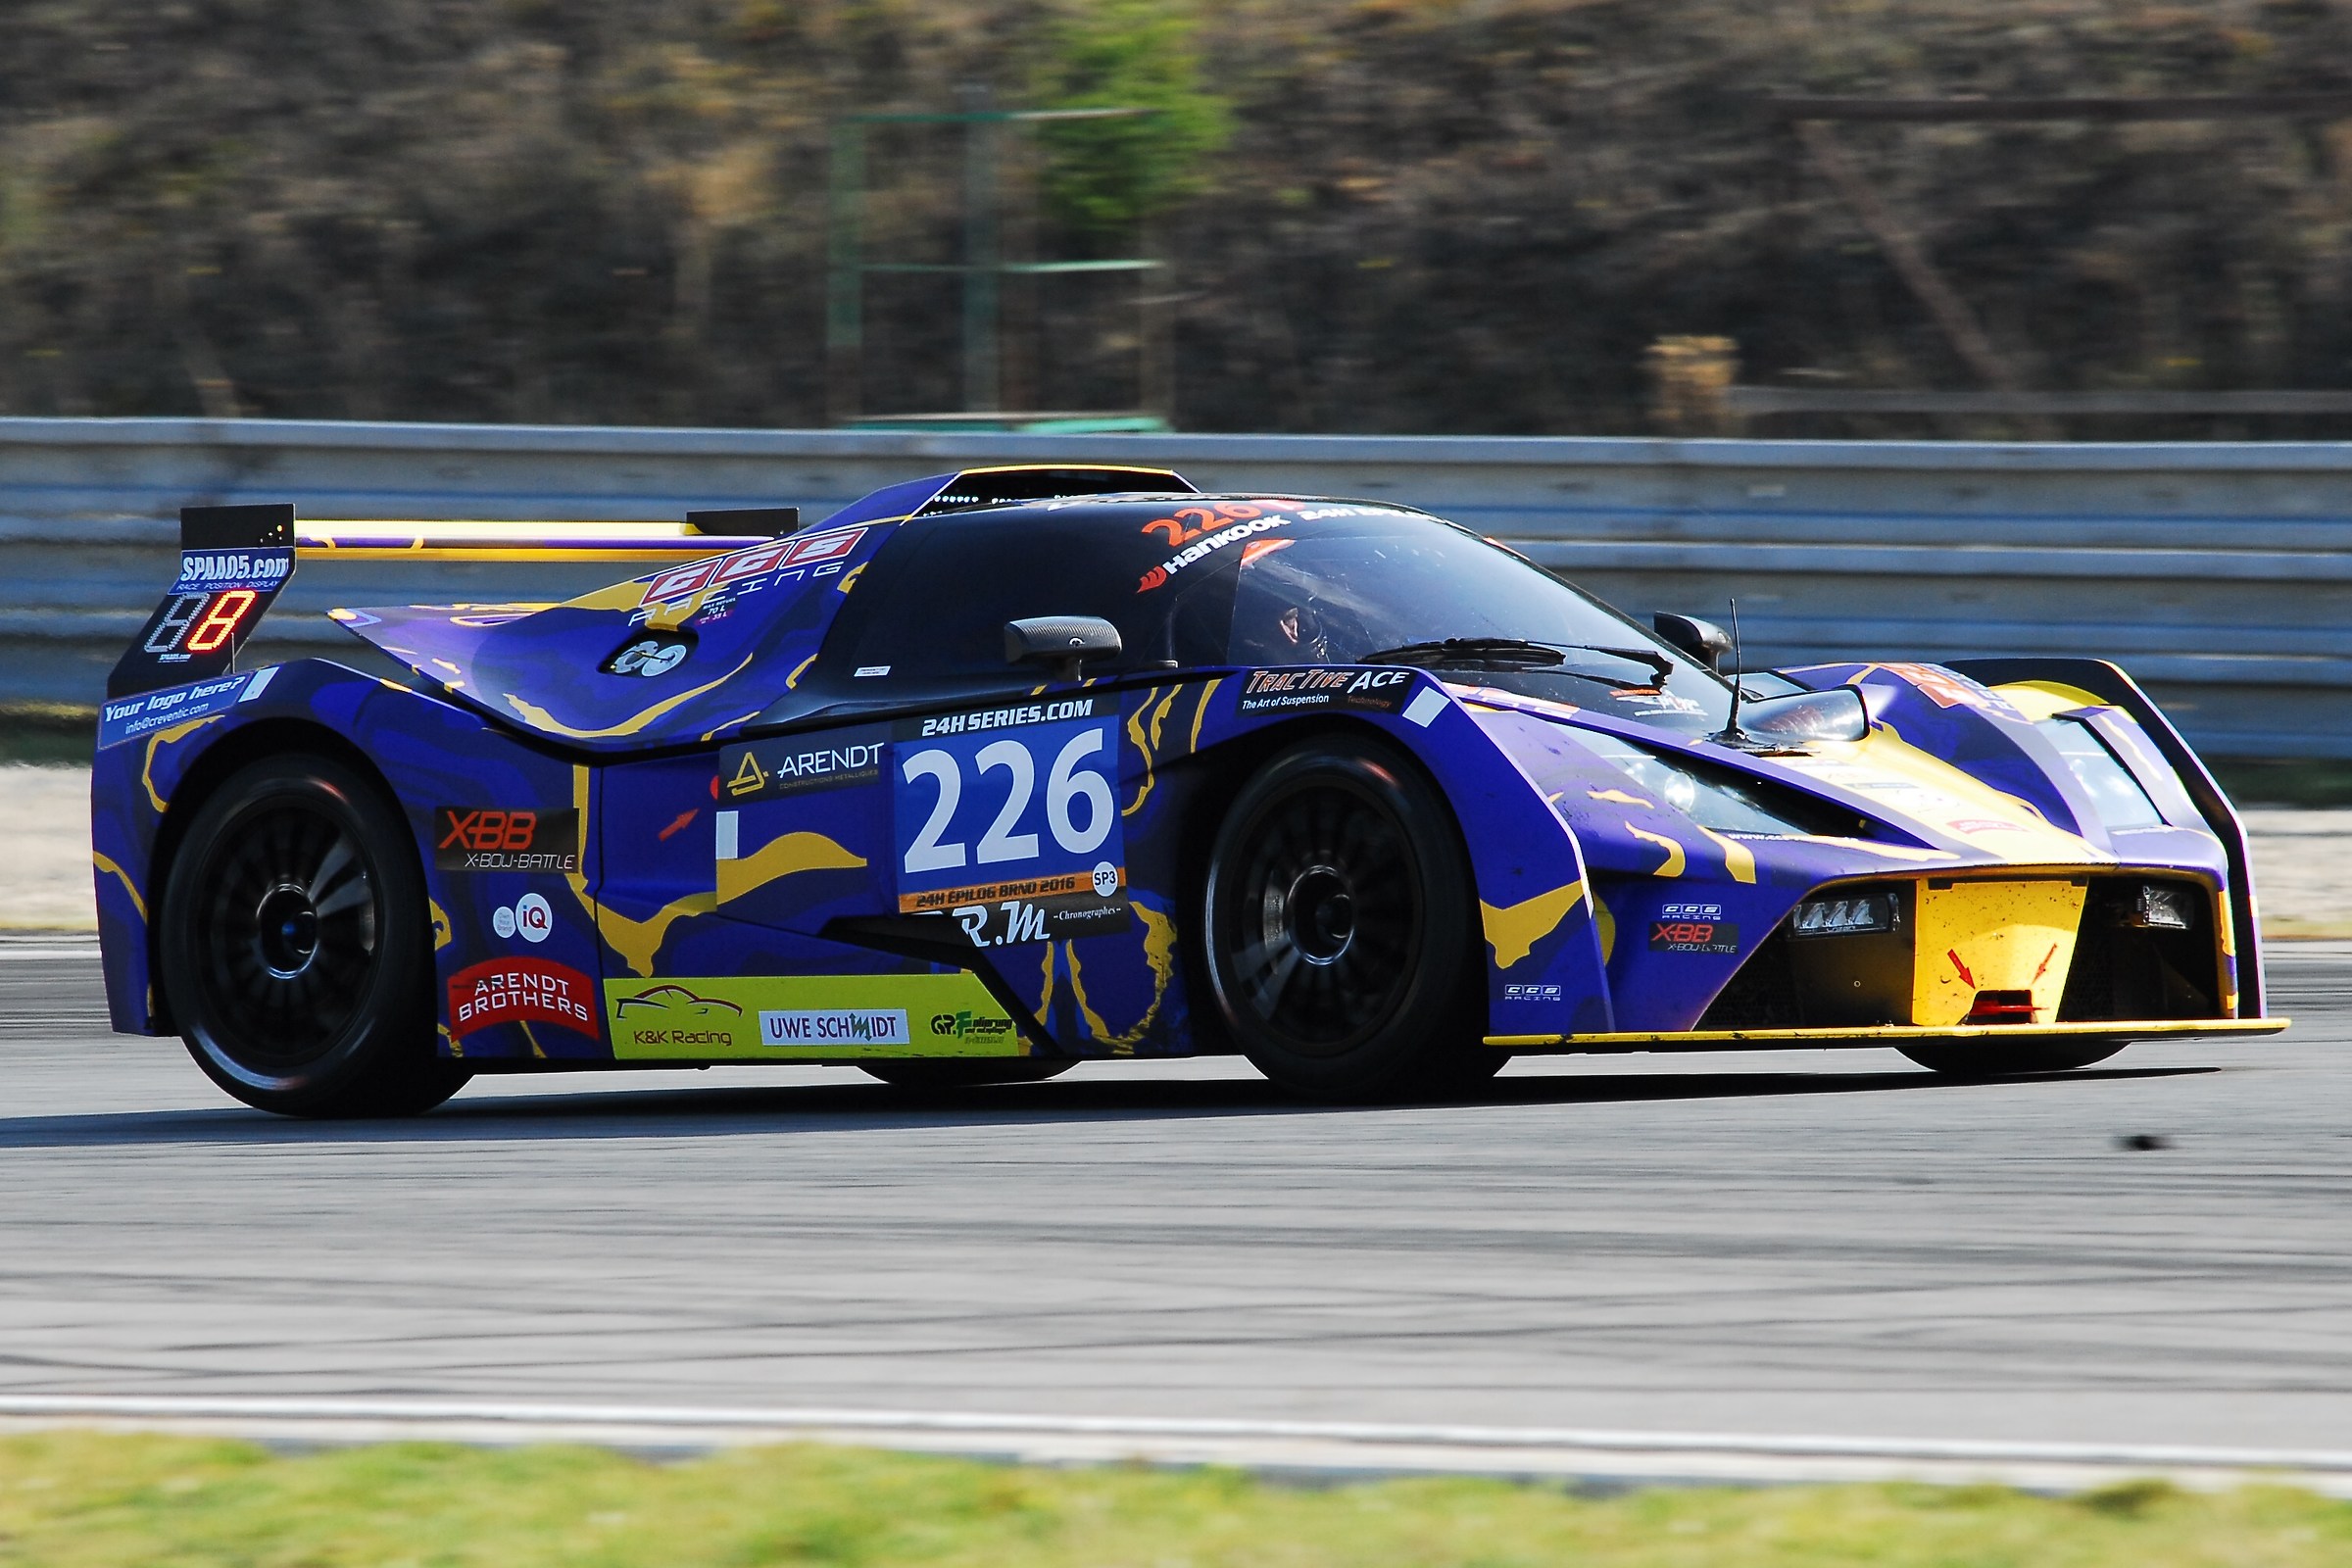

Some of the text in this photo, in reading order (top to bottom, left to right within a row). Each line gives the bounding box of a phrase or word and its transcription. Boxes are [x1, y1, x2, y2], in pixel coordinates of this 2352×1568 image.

[1142, 502, 1262, 547] 226
[246, 580, 280, 589] DISPLAY
[1347, 671, 1410, 694] ACE
[105, 676, 246, 723] Your logo here?
[1242, 694, 1330, 710] The Art of Suspension
[125, 703, 210, 734] info@creventic.com
[777, 742, 885, 778] ARENDT
[903, 728, 1114, 873] 226
[465, 853, 576, 870] X-BOW-BATTLE
[1094, 870, 1117, 887] SP3
[916, 877, 1076, 907] 24H EPILOG BRNO 2016
[522, 905, 549, 929] iQ
[474, 972, 569, 997] ARENDT
[459, 990, 589, 1022] BROTHERS
[634, 1030, 732, 1046] K&K Racing
[769, 1014, 897, 1041] UWE SCHMIDT
